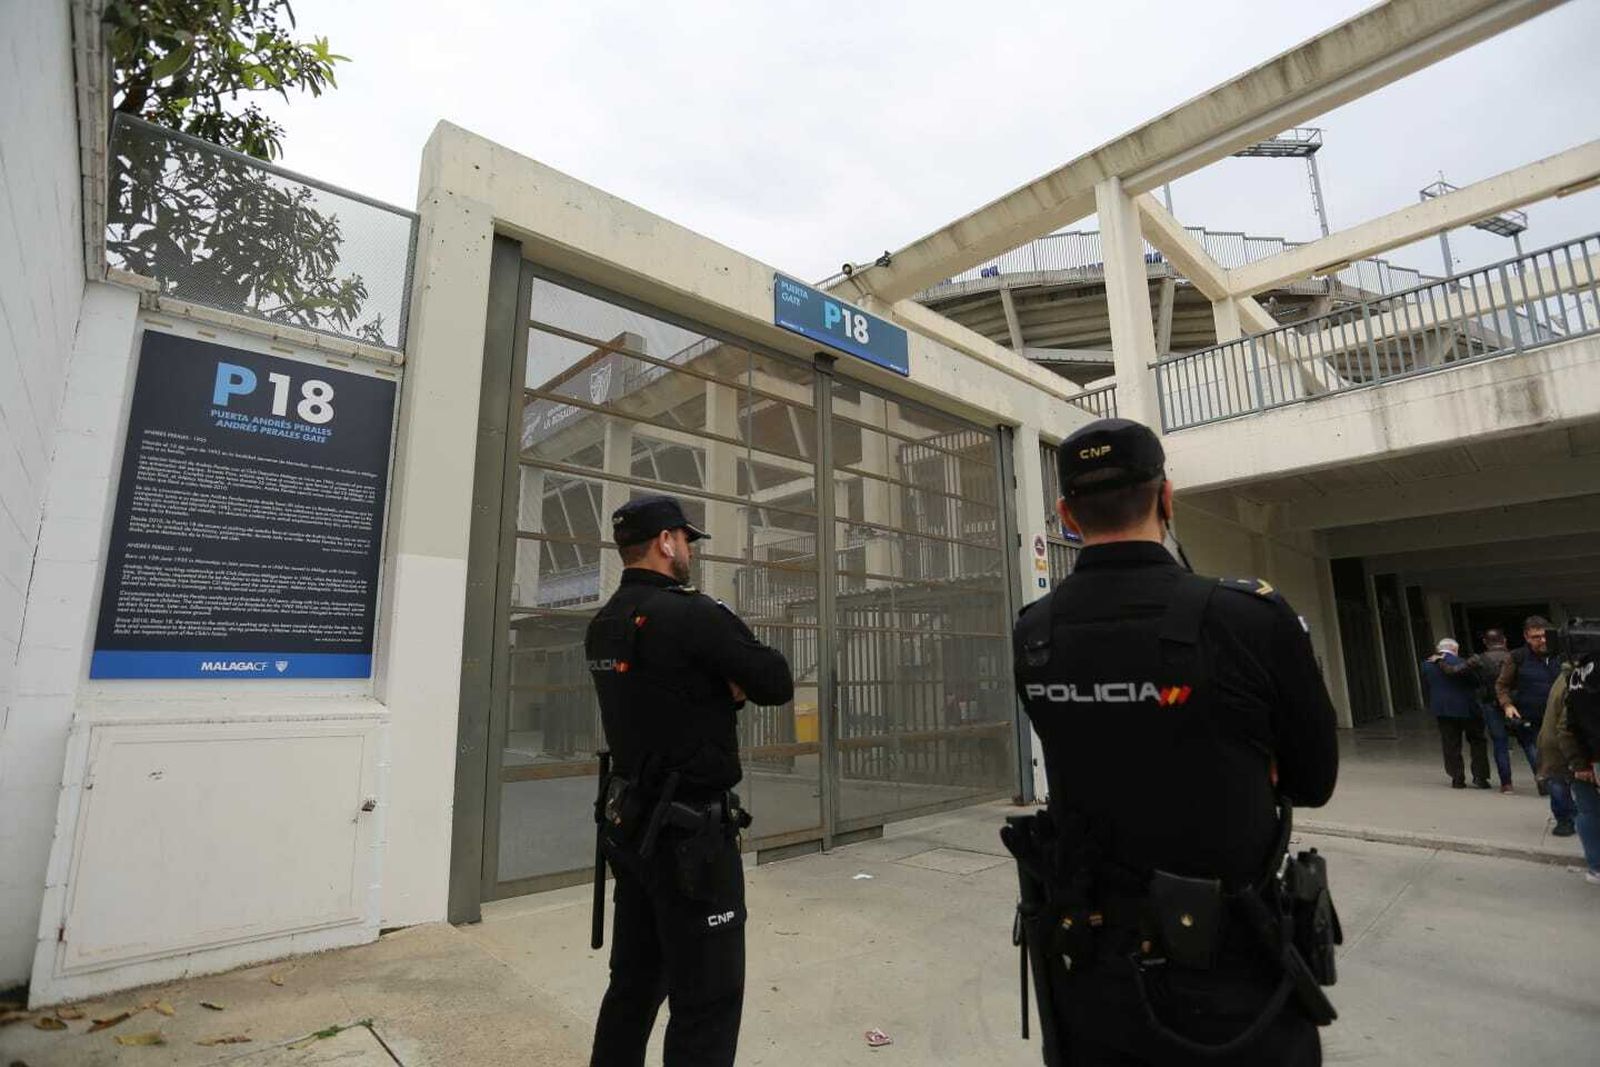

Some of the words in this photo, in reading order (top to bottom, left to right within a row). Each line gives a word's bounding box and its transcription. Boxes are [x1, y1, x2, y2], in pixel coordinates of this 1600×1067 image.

[210, 408, 249, 422] PUERTA
[293, 421, 333, 437] PERALES
[260, 426, 300, 440] PERALES
[302, 432, 327, 444] GATE
[1079, 444, 1112, 460] CNP
[1024, 681, 1162, 702] POLICIA
[707, 910, 735, 927] CNP
